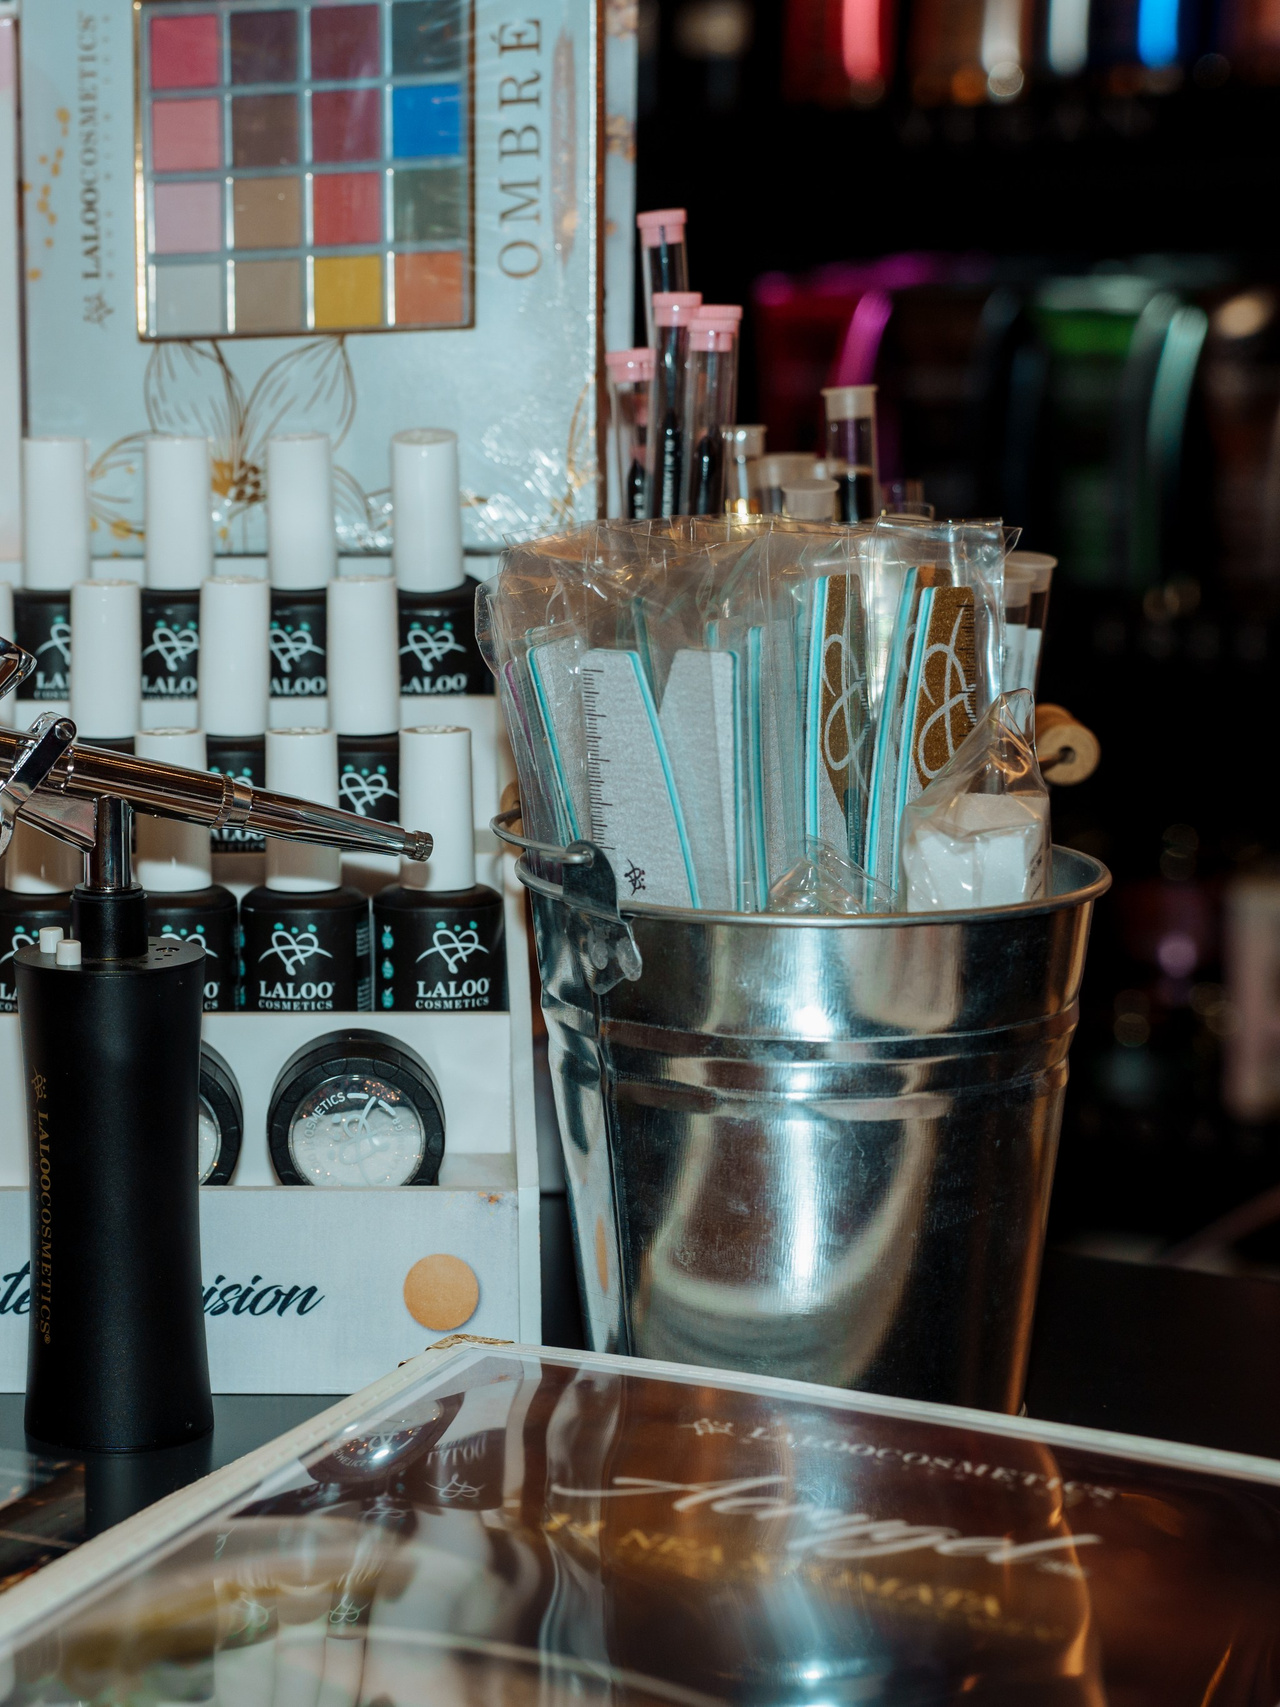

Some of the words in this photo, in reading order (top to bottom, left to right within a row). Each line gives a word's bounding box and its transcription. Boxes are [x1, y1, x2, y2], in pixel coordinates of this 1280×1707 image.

[490, 18, 542, 280] OMBRÉ
[141, 676, 198, 694] LALO
[270, 675, 327, 695] ALOO
[259, 980, 333, 999] LALOO
[416, 978, 489, 998] LALOO
[258, 1000, 333, 1011] COSMETICS
[415, 997, 489, 1010] COSMETICS
[202, 1275, 326, 1318] ision
